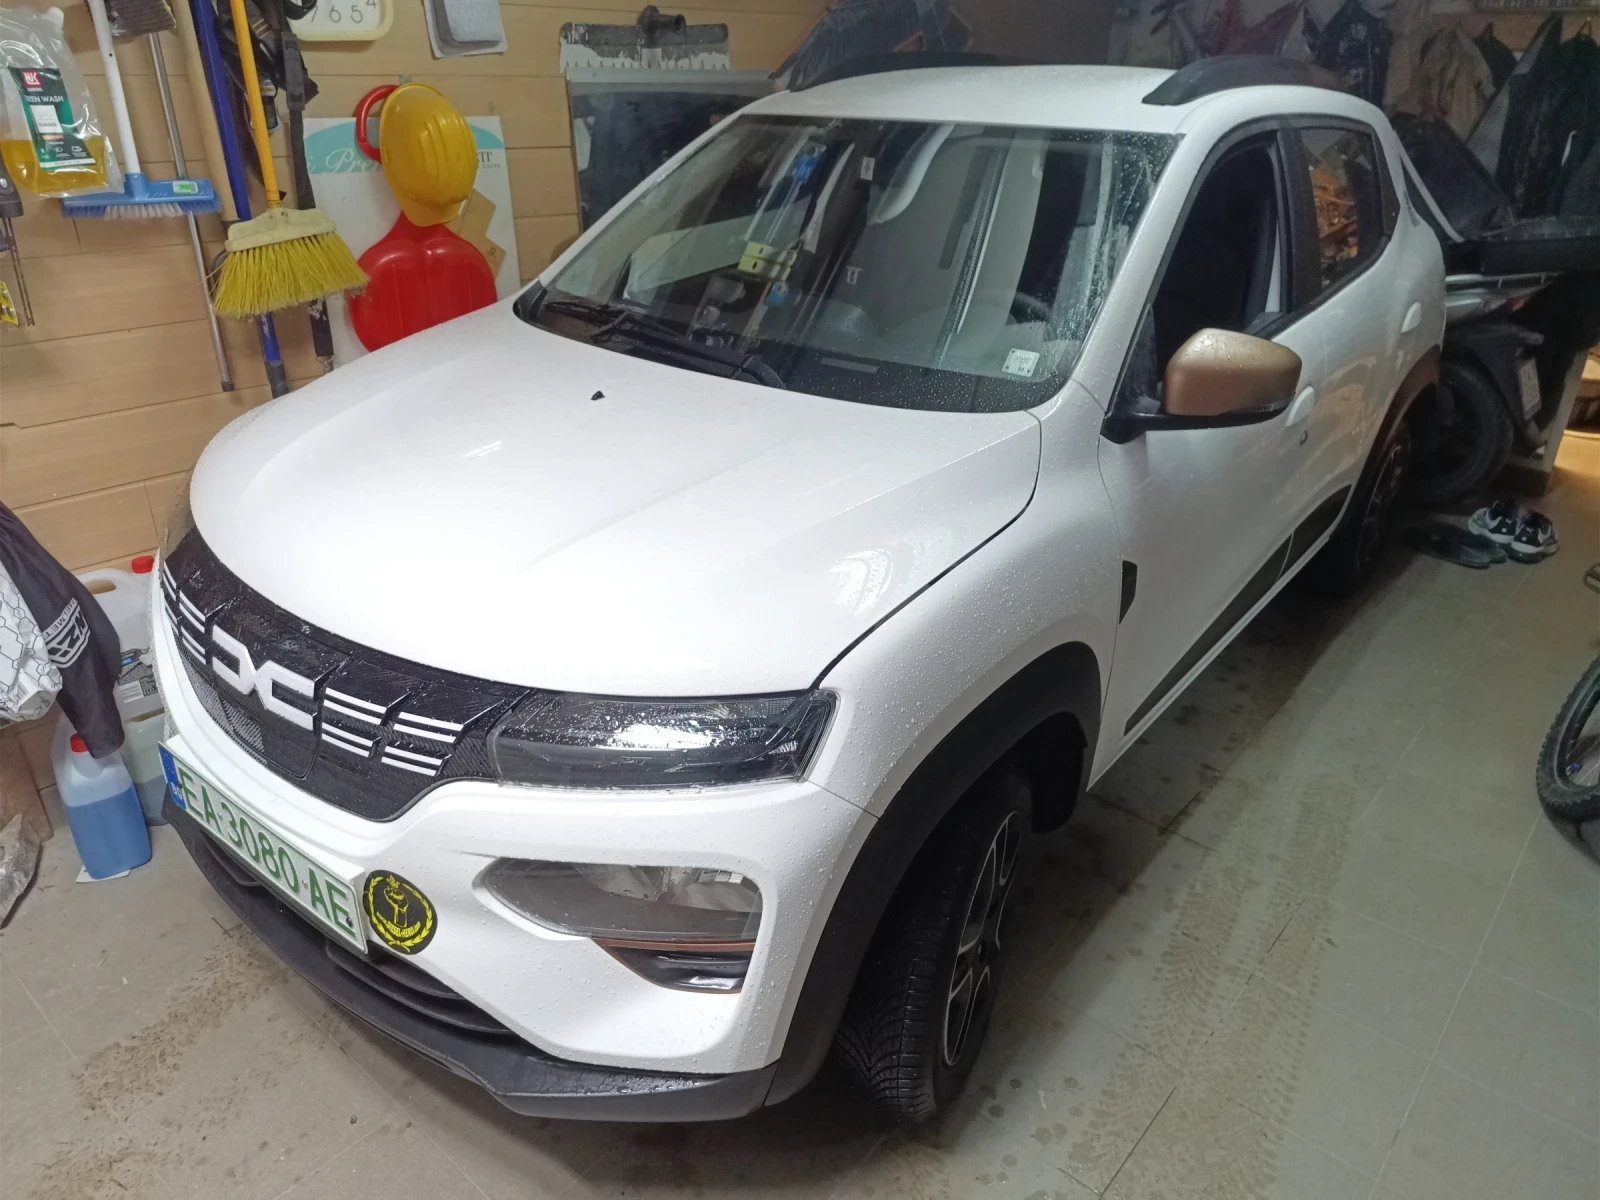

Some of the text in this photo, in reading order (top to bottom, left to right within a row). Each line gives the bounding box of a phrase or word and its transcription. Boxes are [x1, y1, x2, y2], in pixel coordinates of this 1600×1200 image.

[329, 5, 341, 23] 6
[350, 5, 363, 23] 5
[44, 600, 76, 639] HELMET
[171, 781, 184, 800] BG
[221, 801, 299, 894] 3080
